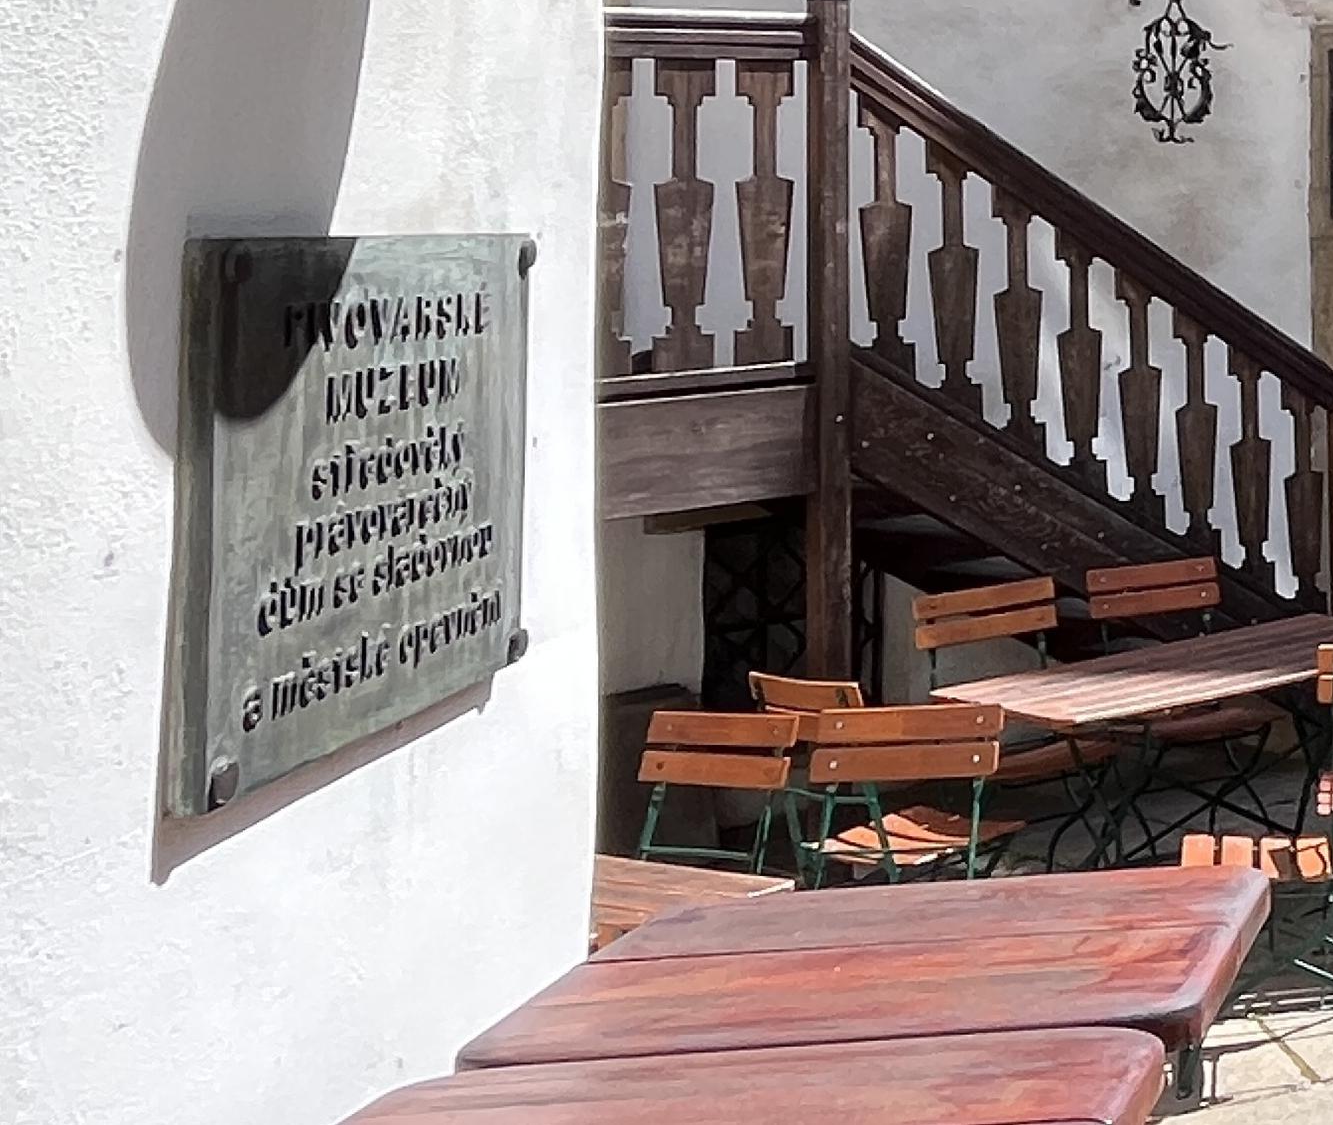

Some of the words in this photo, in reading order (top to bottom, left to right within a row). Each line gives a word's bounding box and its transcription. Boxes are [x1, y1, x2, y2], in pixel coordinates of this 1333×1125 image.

[326, 358, 461, 424] MUZEUM
[333, 565, 365, 609] se
[242, 687, 265, 733] a
